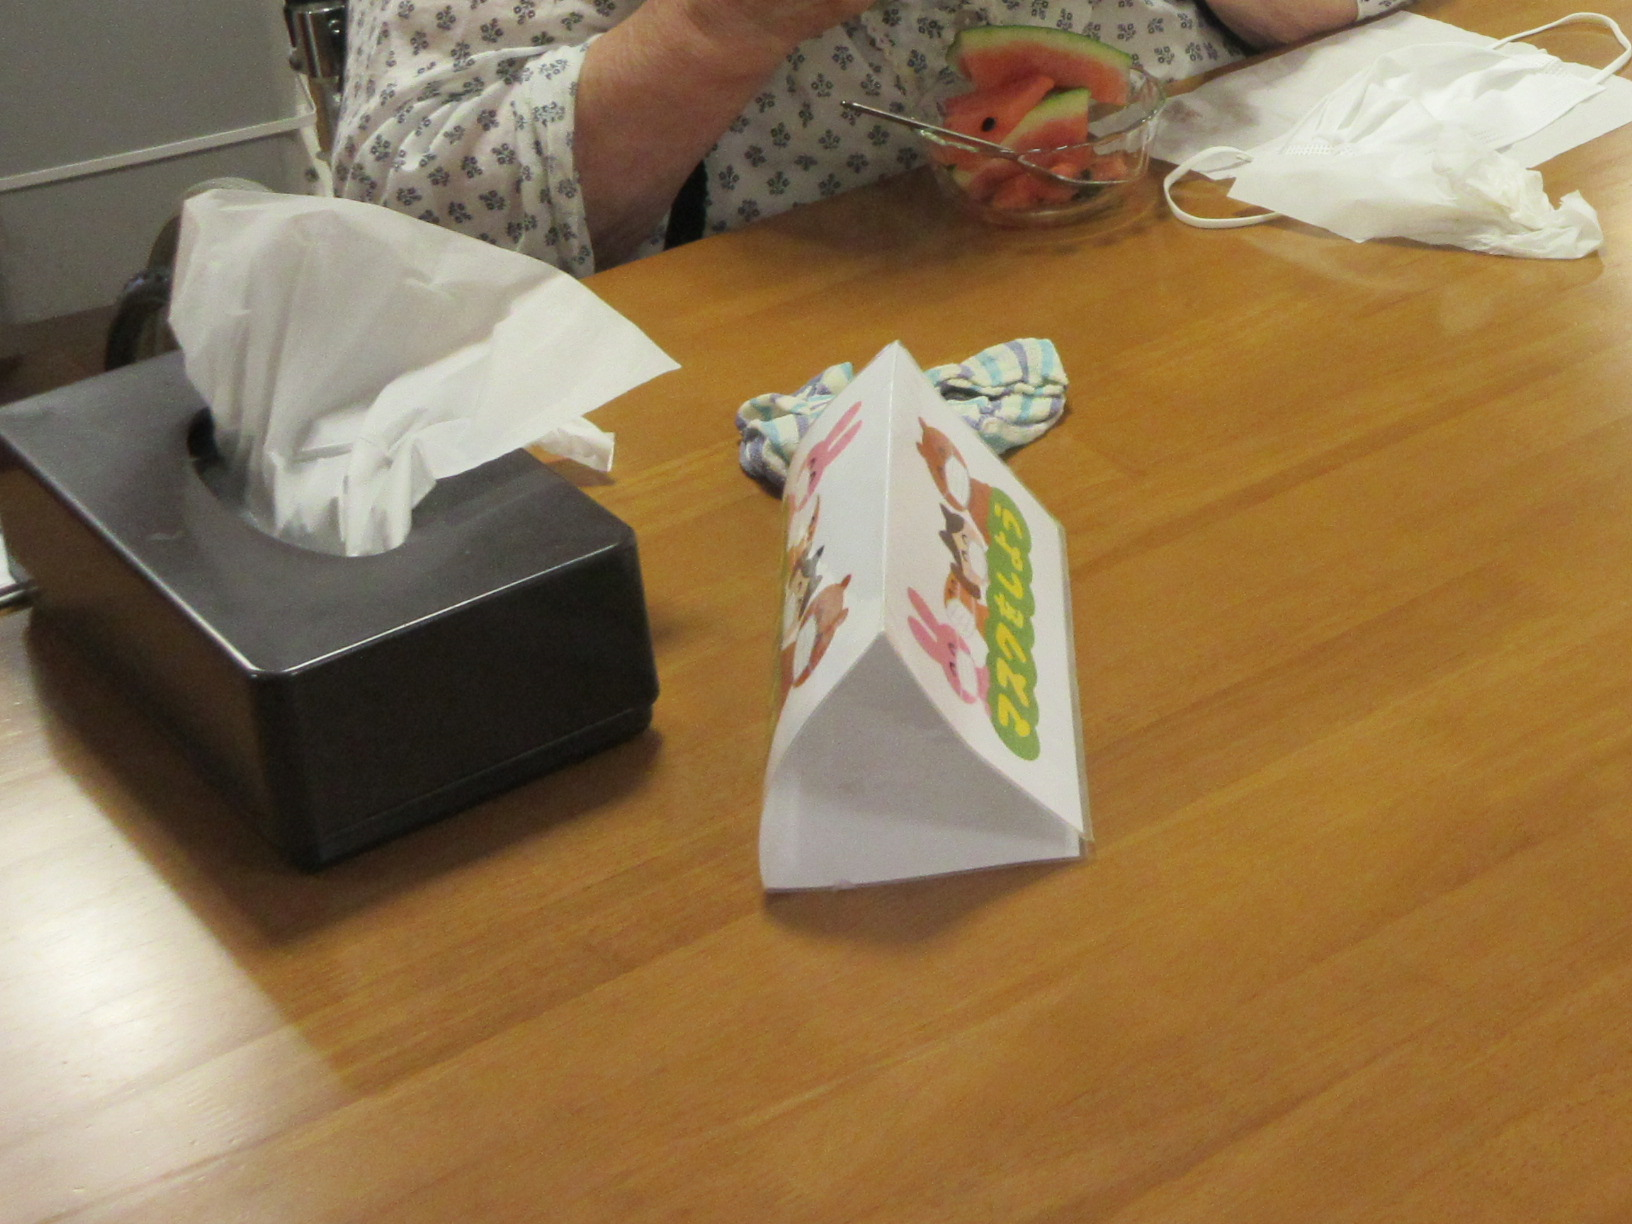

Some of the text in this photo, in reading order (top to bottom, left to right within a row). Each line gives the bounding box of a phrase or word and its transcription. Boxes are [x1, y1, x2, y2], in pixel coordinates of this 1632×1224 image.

[994, 502, 1031, 738] マスクをしよう
